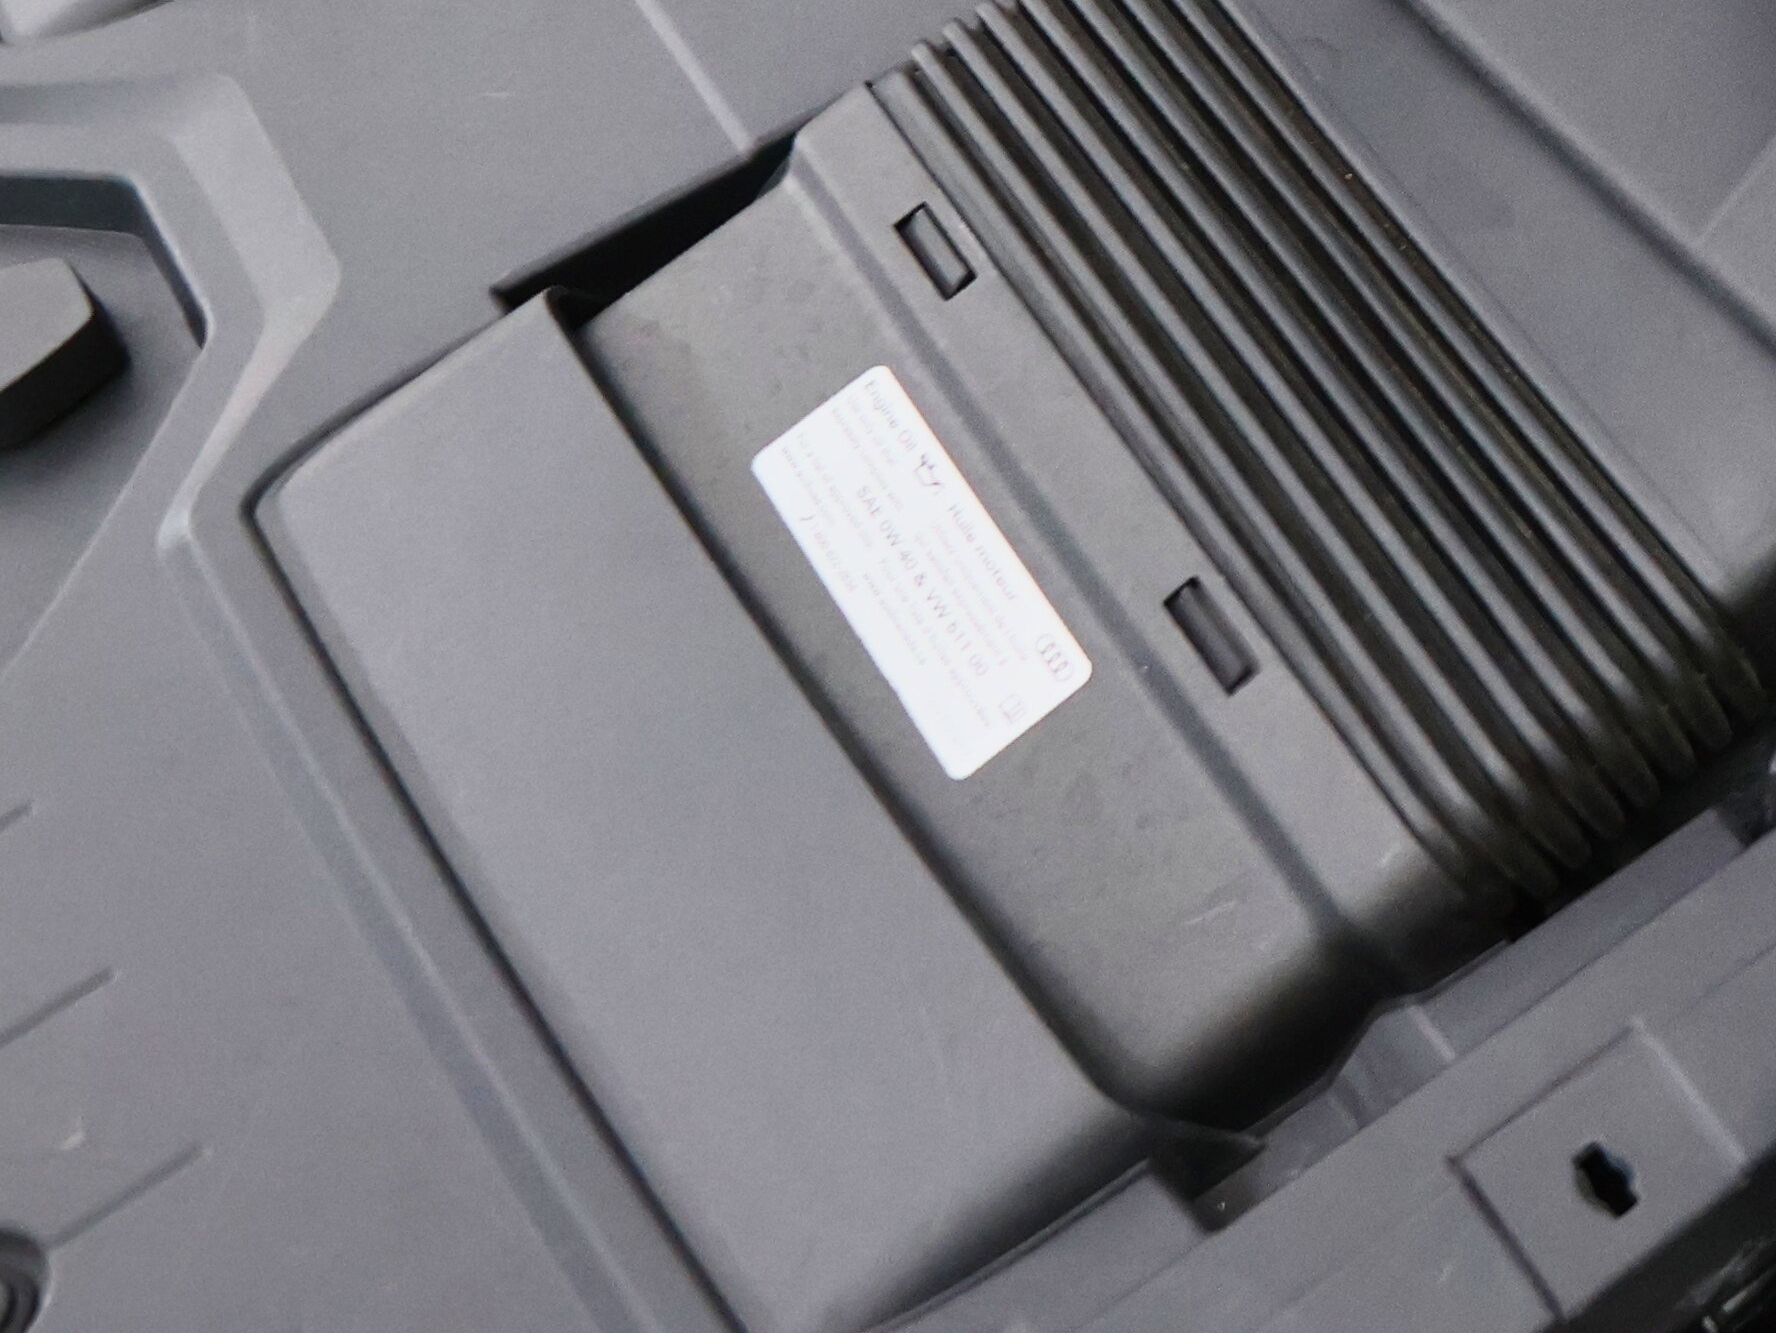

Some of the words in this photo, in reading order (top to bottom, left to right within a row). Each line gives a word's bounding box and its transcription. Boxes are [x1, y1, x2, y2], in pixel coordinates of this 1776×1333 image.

[863, 378, 904, 430] Engine
[895, 427, 920, 453] Oil
[974, 543, 1020, 602] moteur
[921, 585, 953, 621] VW
[965, 651, 992, 678] 00
